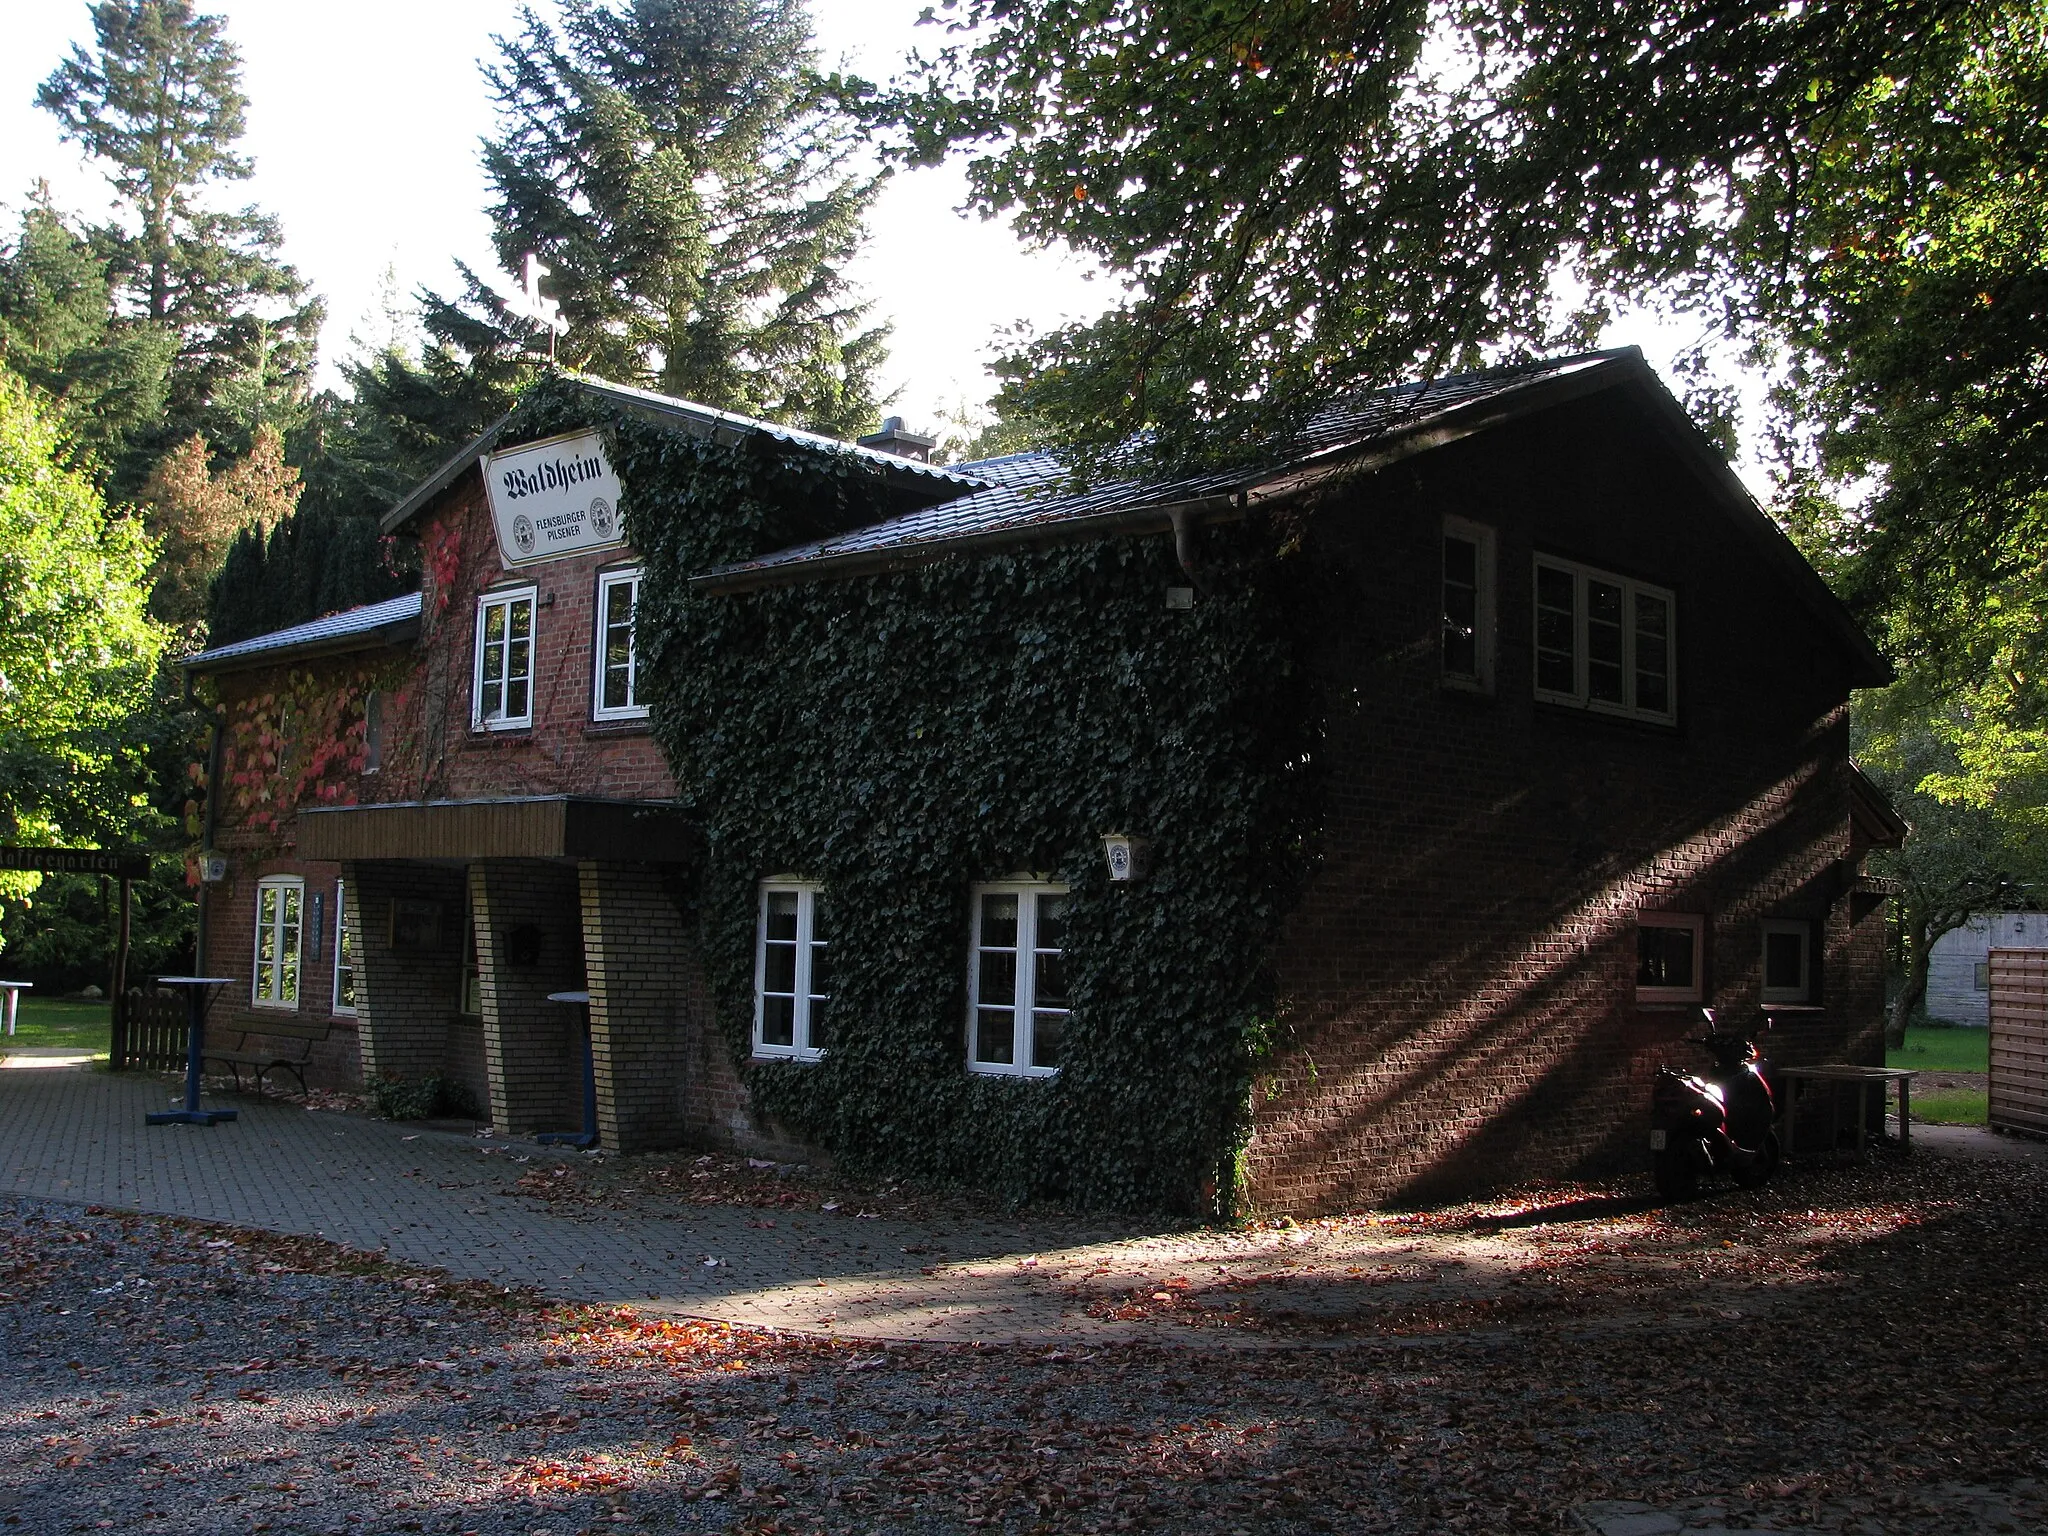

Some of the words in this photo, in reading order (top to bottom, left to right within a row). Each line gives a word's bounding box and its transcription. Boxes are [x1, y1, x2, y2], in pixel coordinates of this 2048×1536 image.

[503, 453, 603, 500] Waldheim
[536, 510, 587, 531] FLENSBURGER
[547, 525, 581, 542] PILSENER
